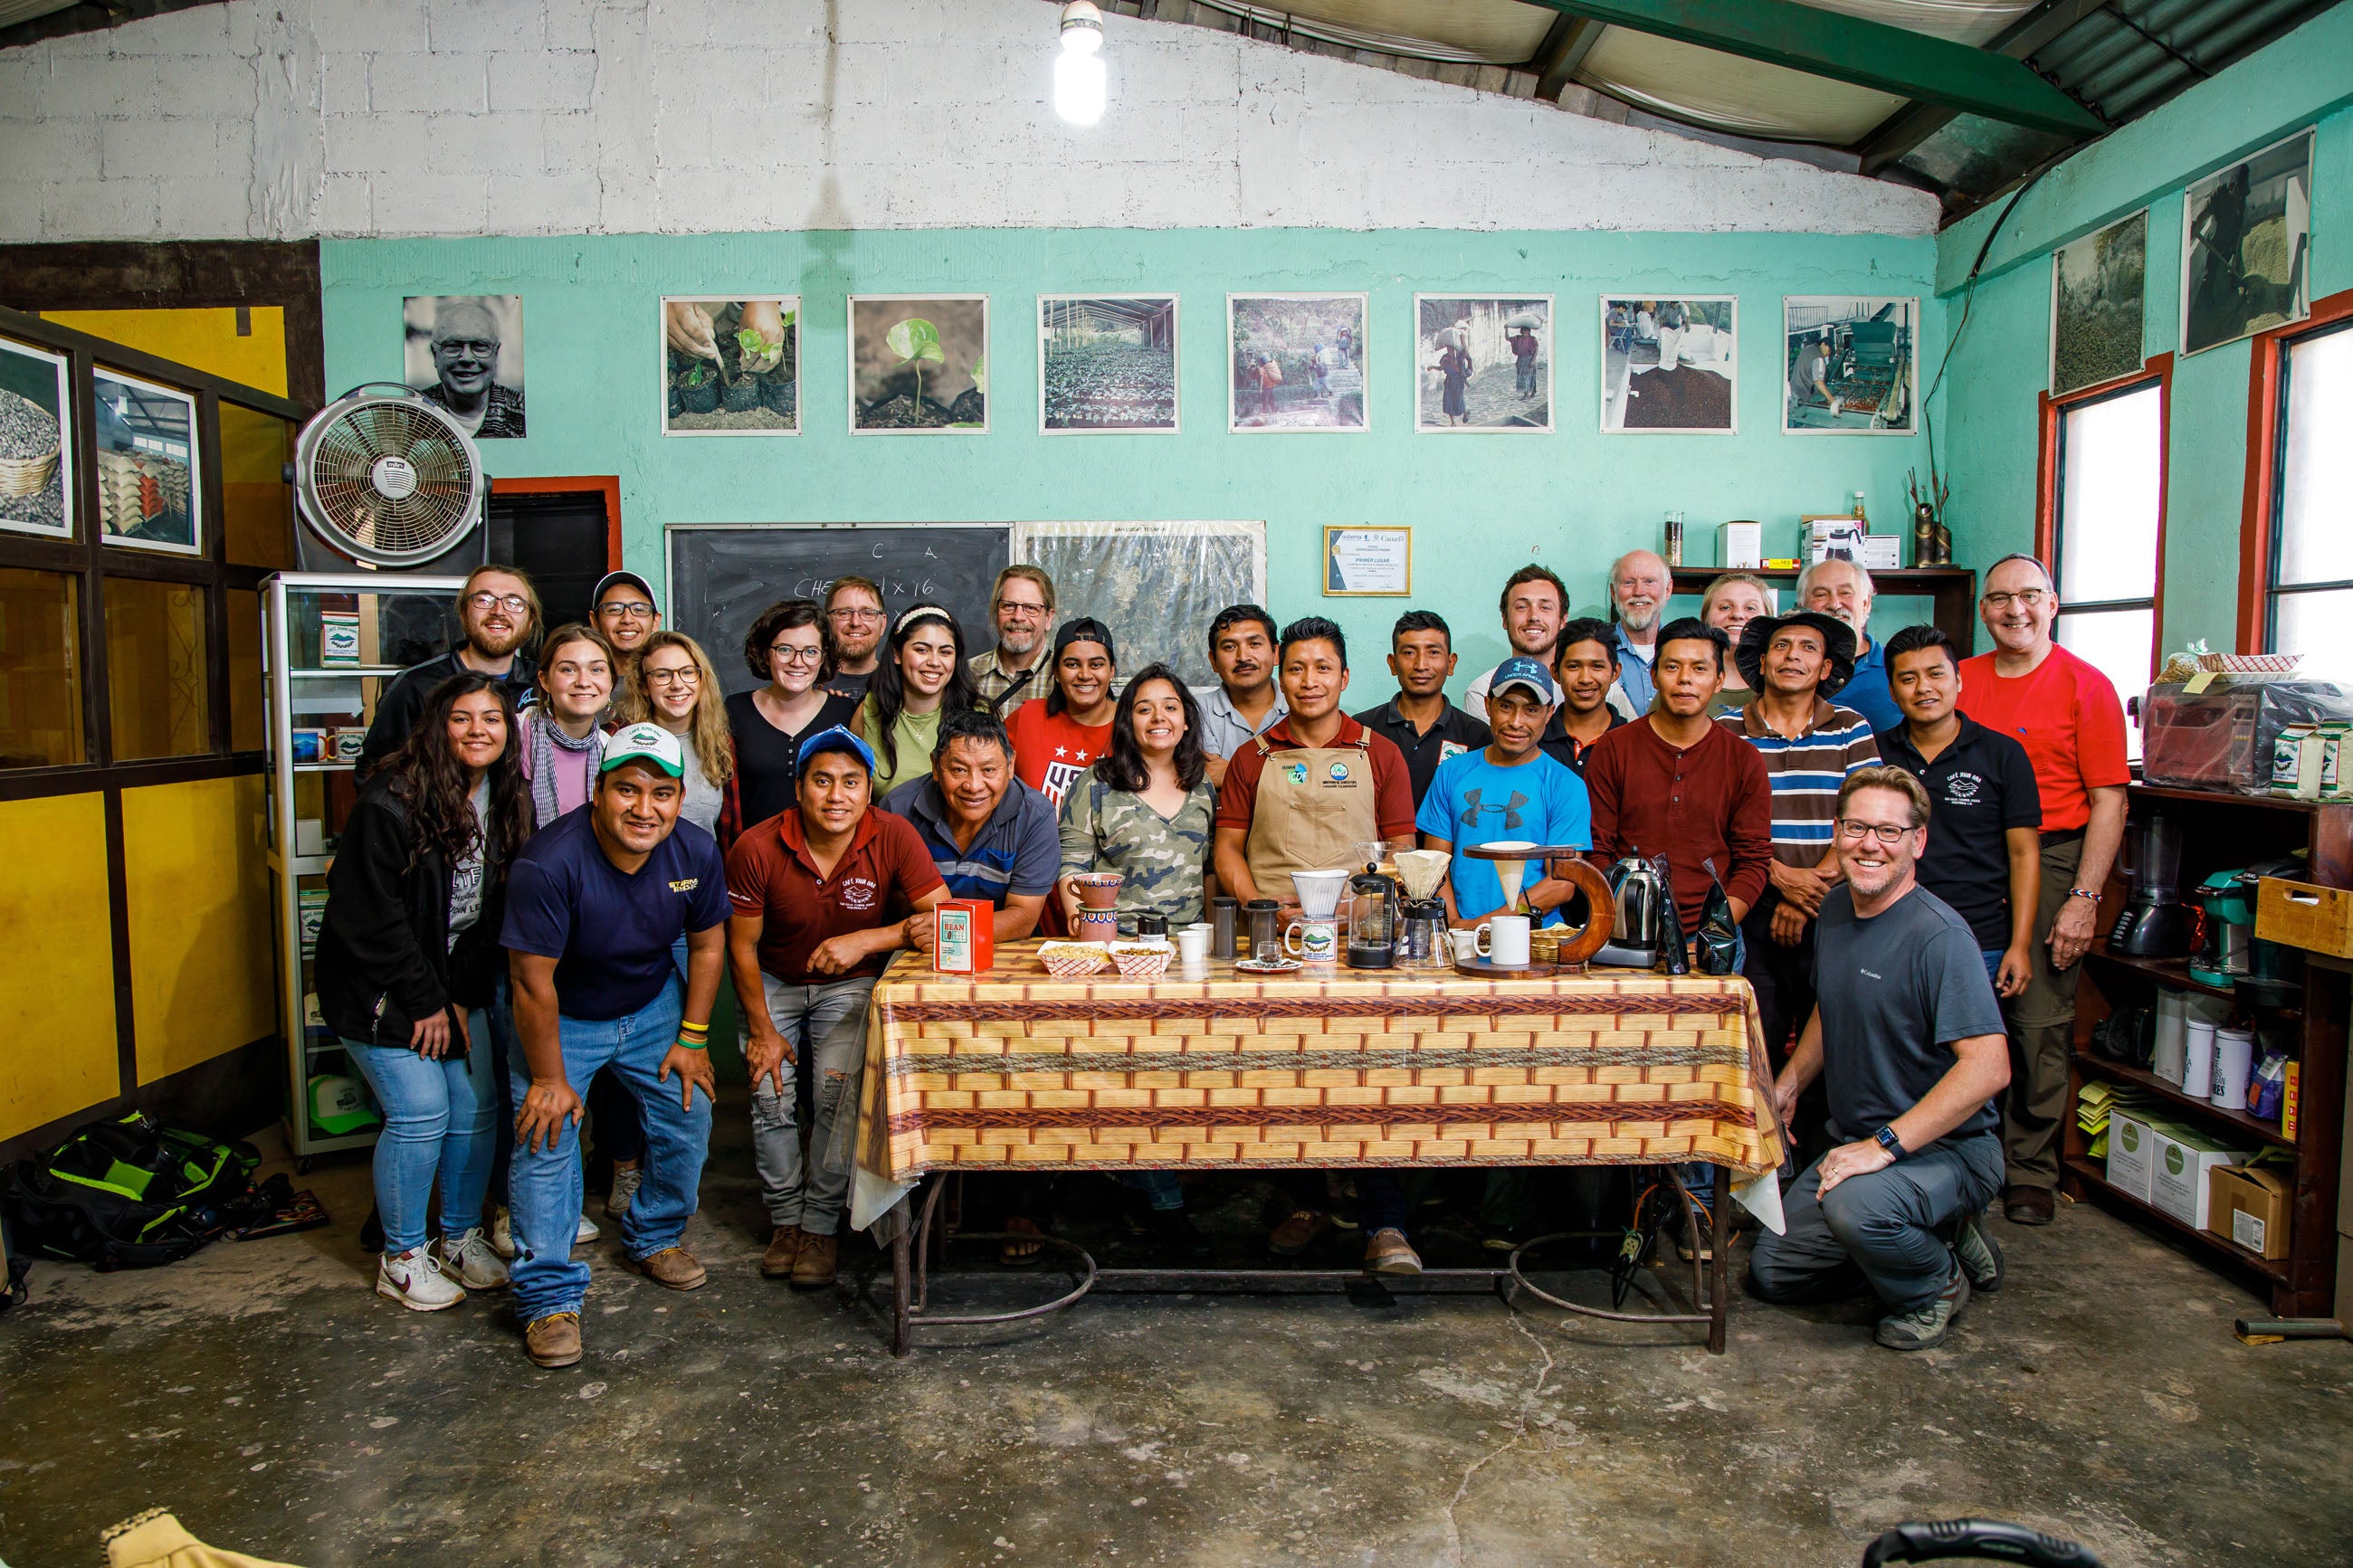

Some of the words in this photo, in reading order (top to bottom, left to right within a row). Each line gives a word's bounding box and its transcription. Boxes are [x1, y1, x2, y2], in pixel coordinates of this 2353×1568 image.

[924, 546, 937, 559] A
[914, 578, 934, 597] 16
[943, 931, 965, 941] COFFEE
